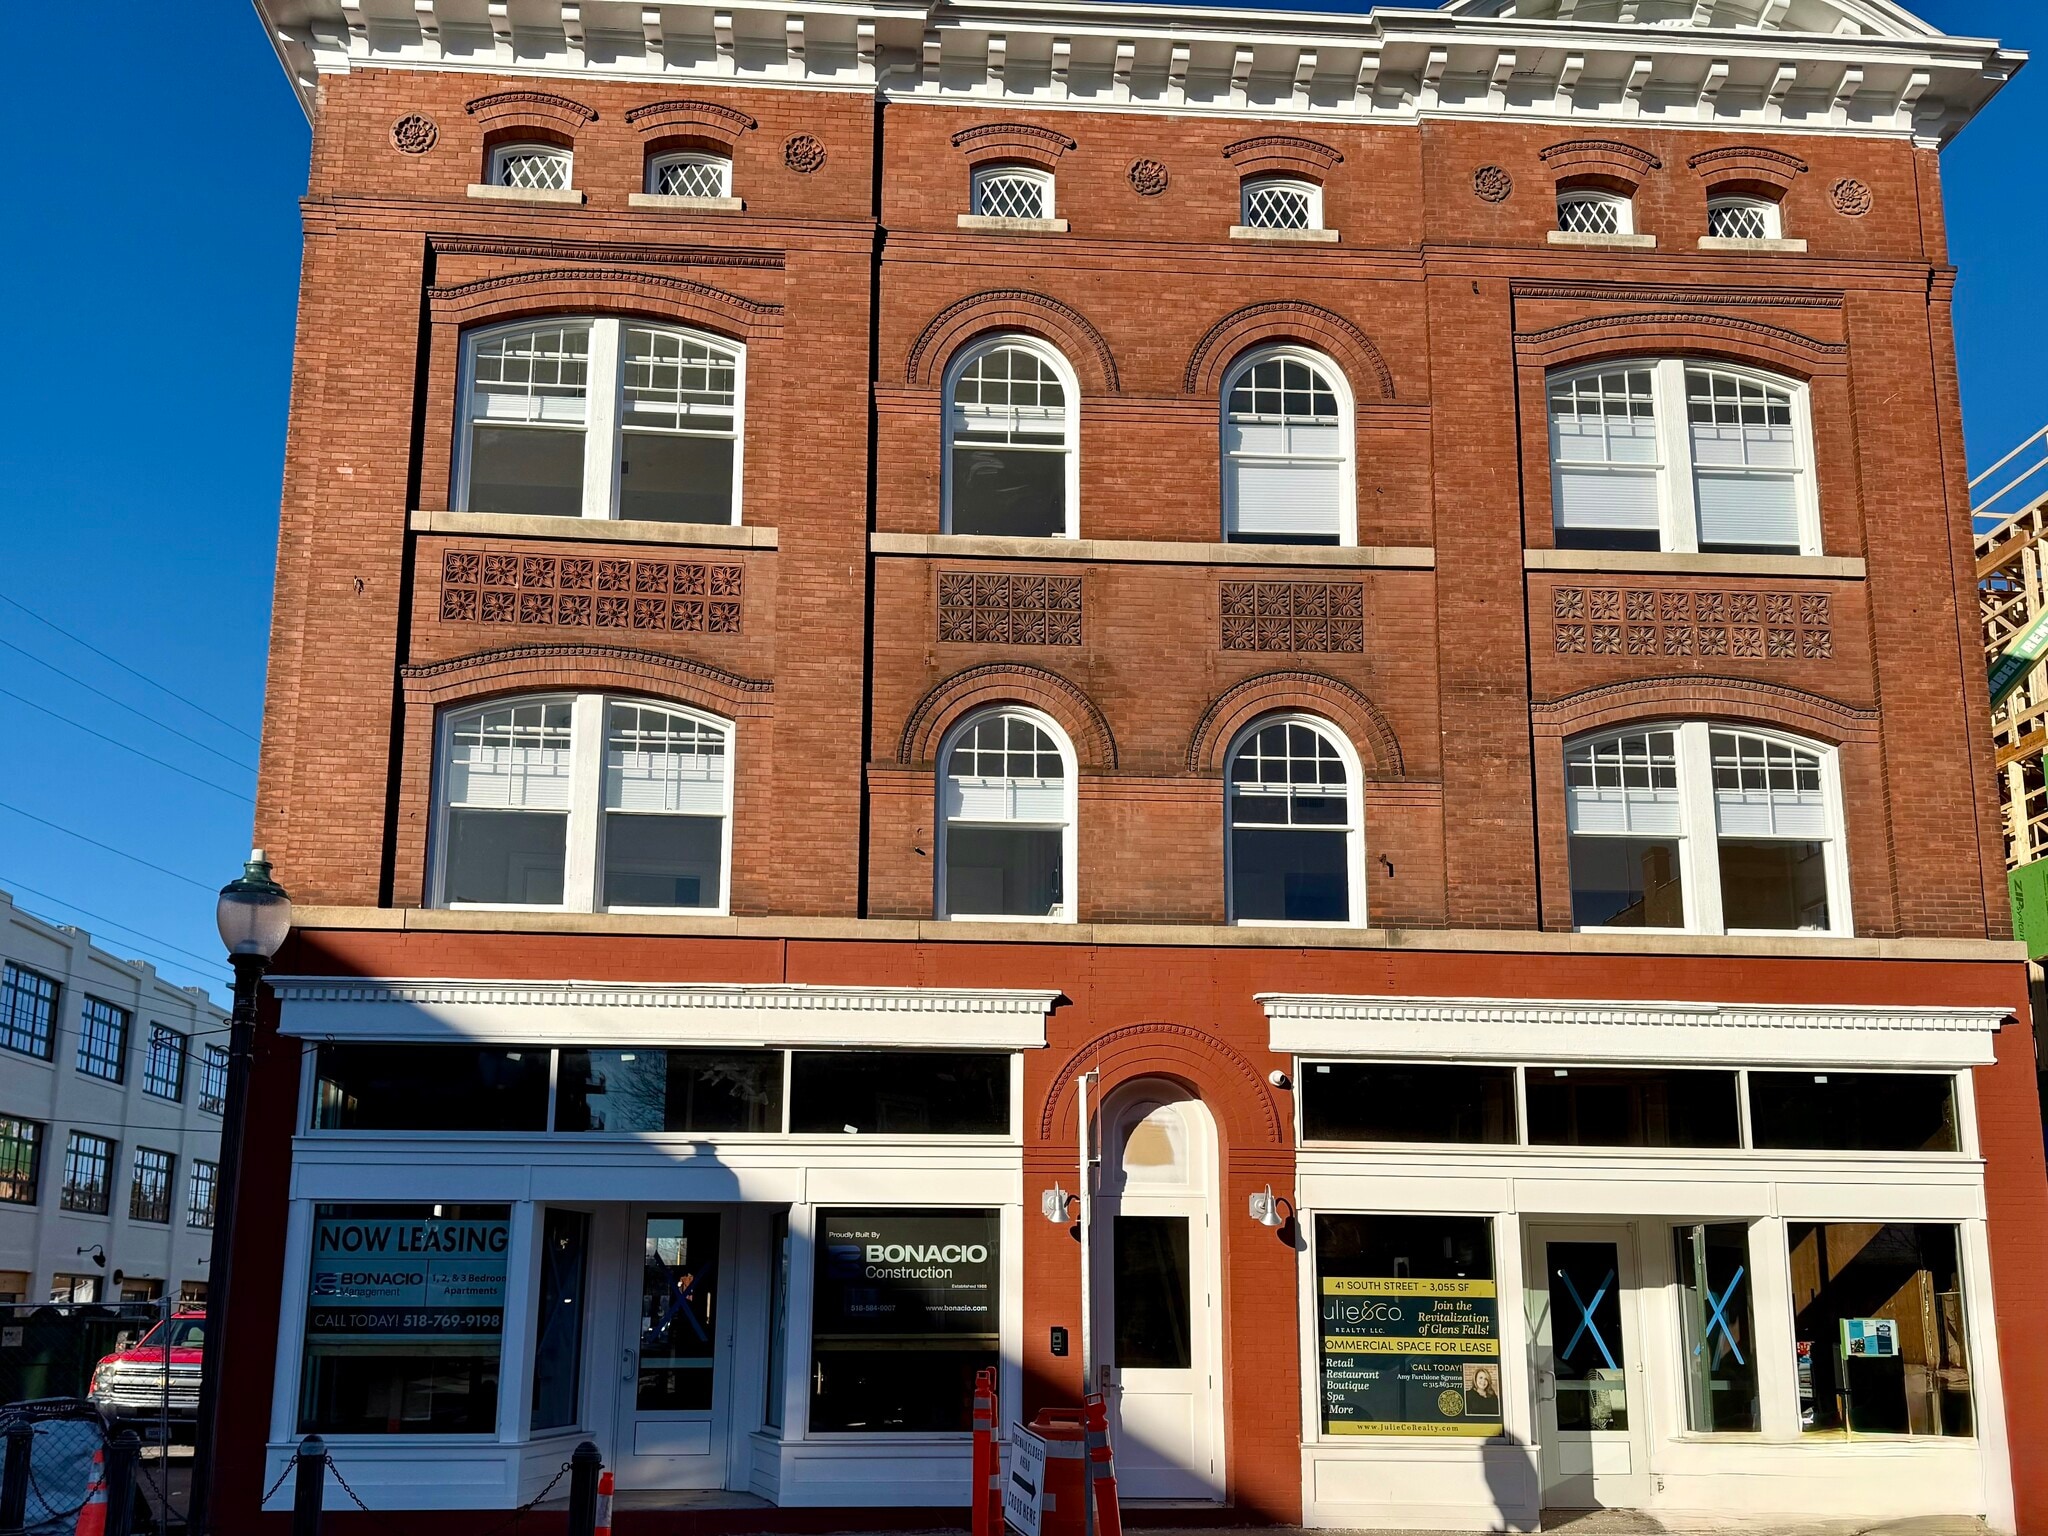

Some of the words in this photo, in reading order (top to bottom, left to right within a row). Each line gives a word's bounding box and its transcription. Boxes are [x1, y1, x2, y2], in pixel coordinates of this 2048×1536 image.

[320, 1226, 391, 1251] NOW
[398, 1226, 508, 1252] LEASING
[866, 1244, 988, 1263] BONACIO
[865, 1266, 953, 1279] Construction
[341, 1272, 423, 1285] BONACIO
[441, 1275, 450, 1283] 2,
[340, 1287, 400, 1297] Management
[444, 1286, 498, 1295] Apartments
[1335, 1281, 1344, 1289] 41
[1348, 1281, 1381, 1290] SOUTH
[1384, 1281, 1418, 1291] STREET
[1430, 1283, 1455, 1292] 3,055
[1458, 1283, 1469, 1291] SF
[1433, 1300, 1453, 1311] Join
[1456, 1300, 1472, 1311] the
[315, 1315, 346, 1327] CALL
[349, 1315, 399, 1327] TODAY!
[403, 1315, 500, 1327] 518-769-9198
[1418, 1312, 1489, 1323] Revitalization
[1418, 1323, 1430, 1336] of
[1431, 1323, 1459, 1334] Glens
[1462, 1324, 1489, 1335] Falls!
[1325, 1340, 1394, 1351] OMMERCIAL
[1397, 1341, 1431, 1351] SPACE
[1435, 1342, 1456, 1352] FOR
[1460, 1343, 1492, 1352] LEASE
[1326, 1358, 1354, 1368] Retail
[1326, 1369, 1380, 1379] Restaurant
[1396, 1373, 1411, 1381] Amy
[1326, 1380, 1370, 1393] Boutique
[1327, 1391, 1345, 1403] Spa
[1329, 1404, 1354, 1414] More
[1357, 1423, 1459, 1432] www.JulieCoRealty.com
[1008, 1491, 1023, 1516] CROSS
[1023, 1503, 1036, 1527] HERE
